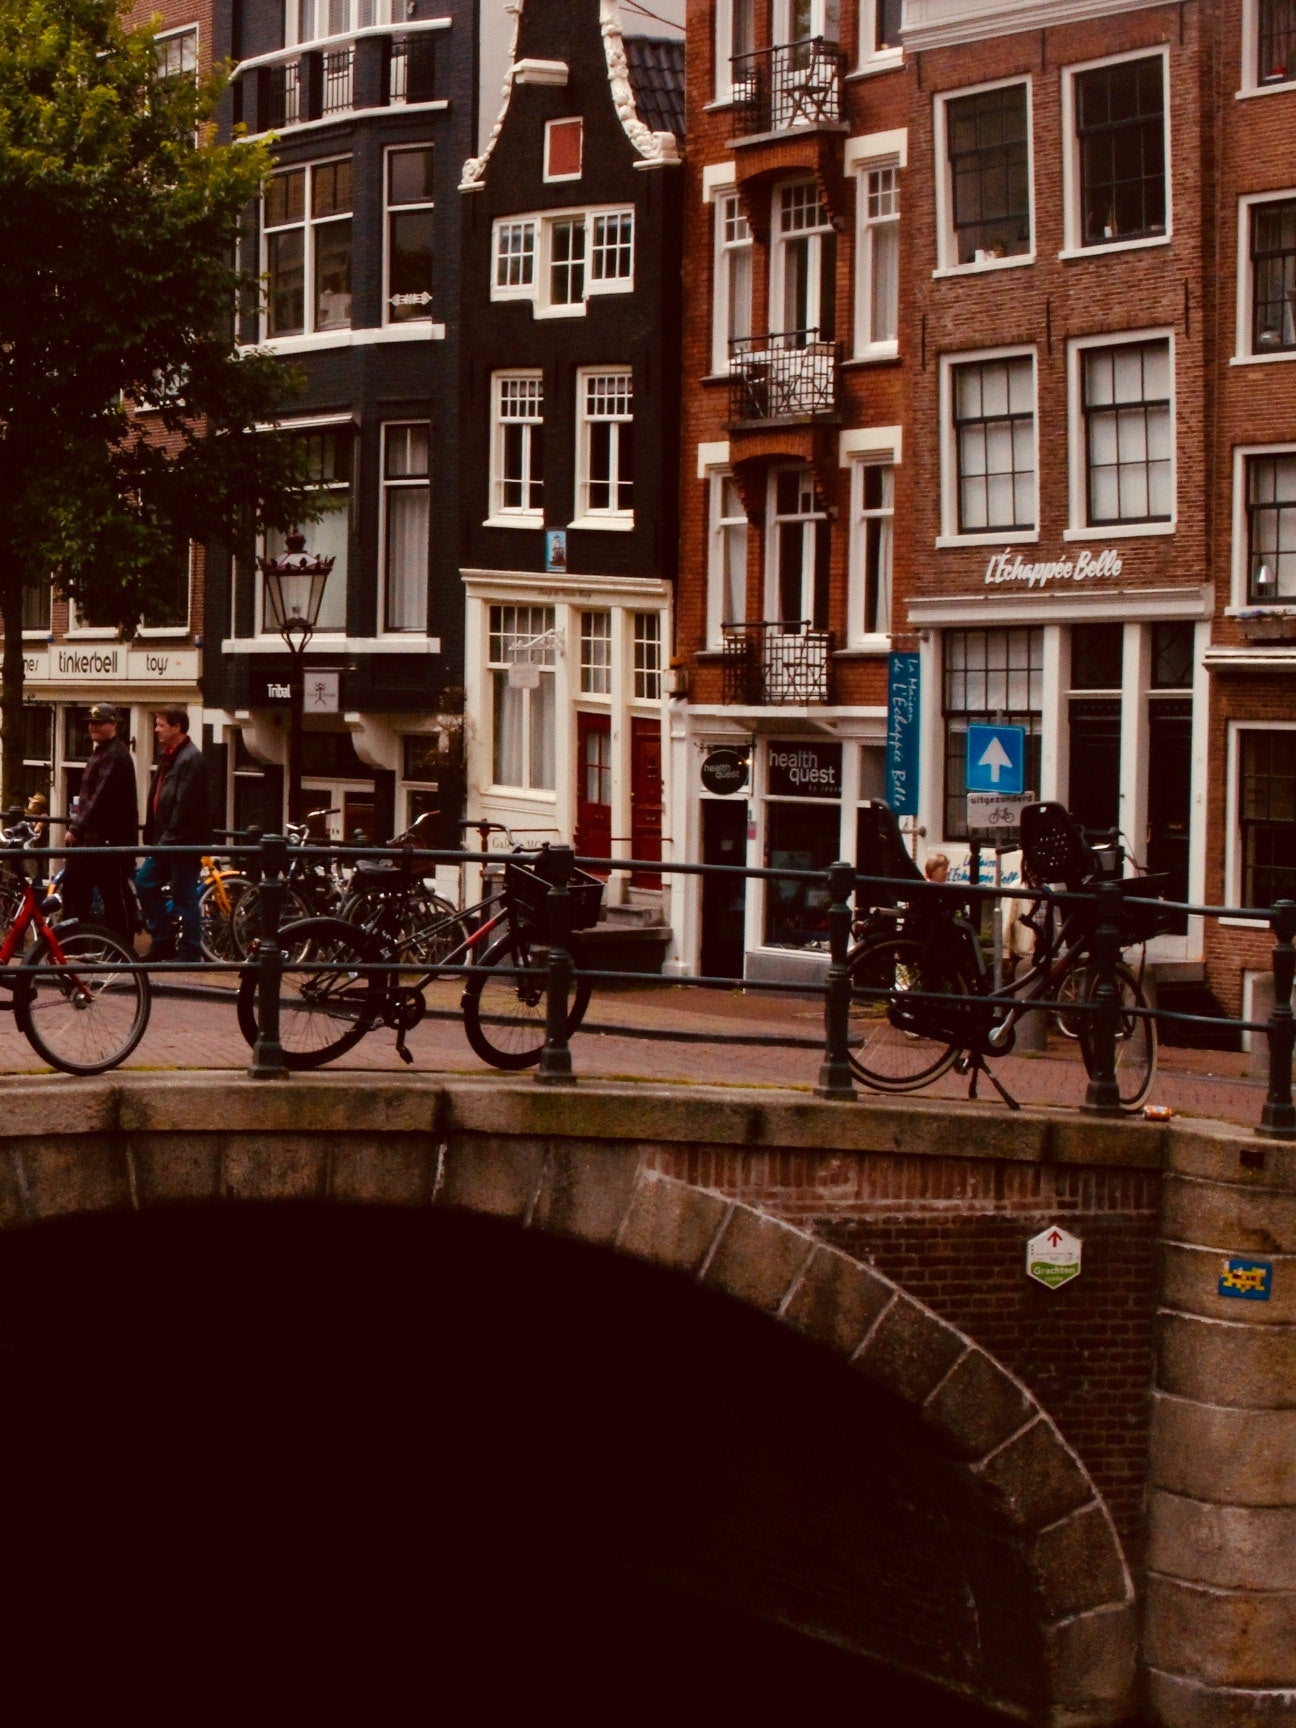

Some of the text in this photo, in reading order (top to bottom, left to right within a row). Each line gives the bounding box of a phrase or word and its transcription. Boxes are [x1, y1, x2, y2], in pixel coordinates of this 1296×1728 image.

[984, 546, 1123, 588] L'Échappée Belle
[59, 651, 118, 673] tinkerbell
[146, 654, 169, 675] toys
[893, 658, 905, 674] de
[266, 683, 291, 699] Tribal
[907, 658, 919, 723] La Maison
[703, 763, 732, 773] health
[768, 748, 818, 768] health
[715, 770, 740, 780] quest
[789, 766, 836, 786] quest
[892, 769, 906, 807] Belle
[970, 795, 1033, 805] uitgezonderd
[1034, 1266, 1076, 1275] Grachten
